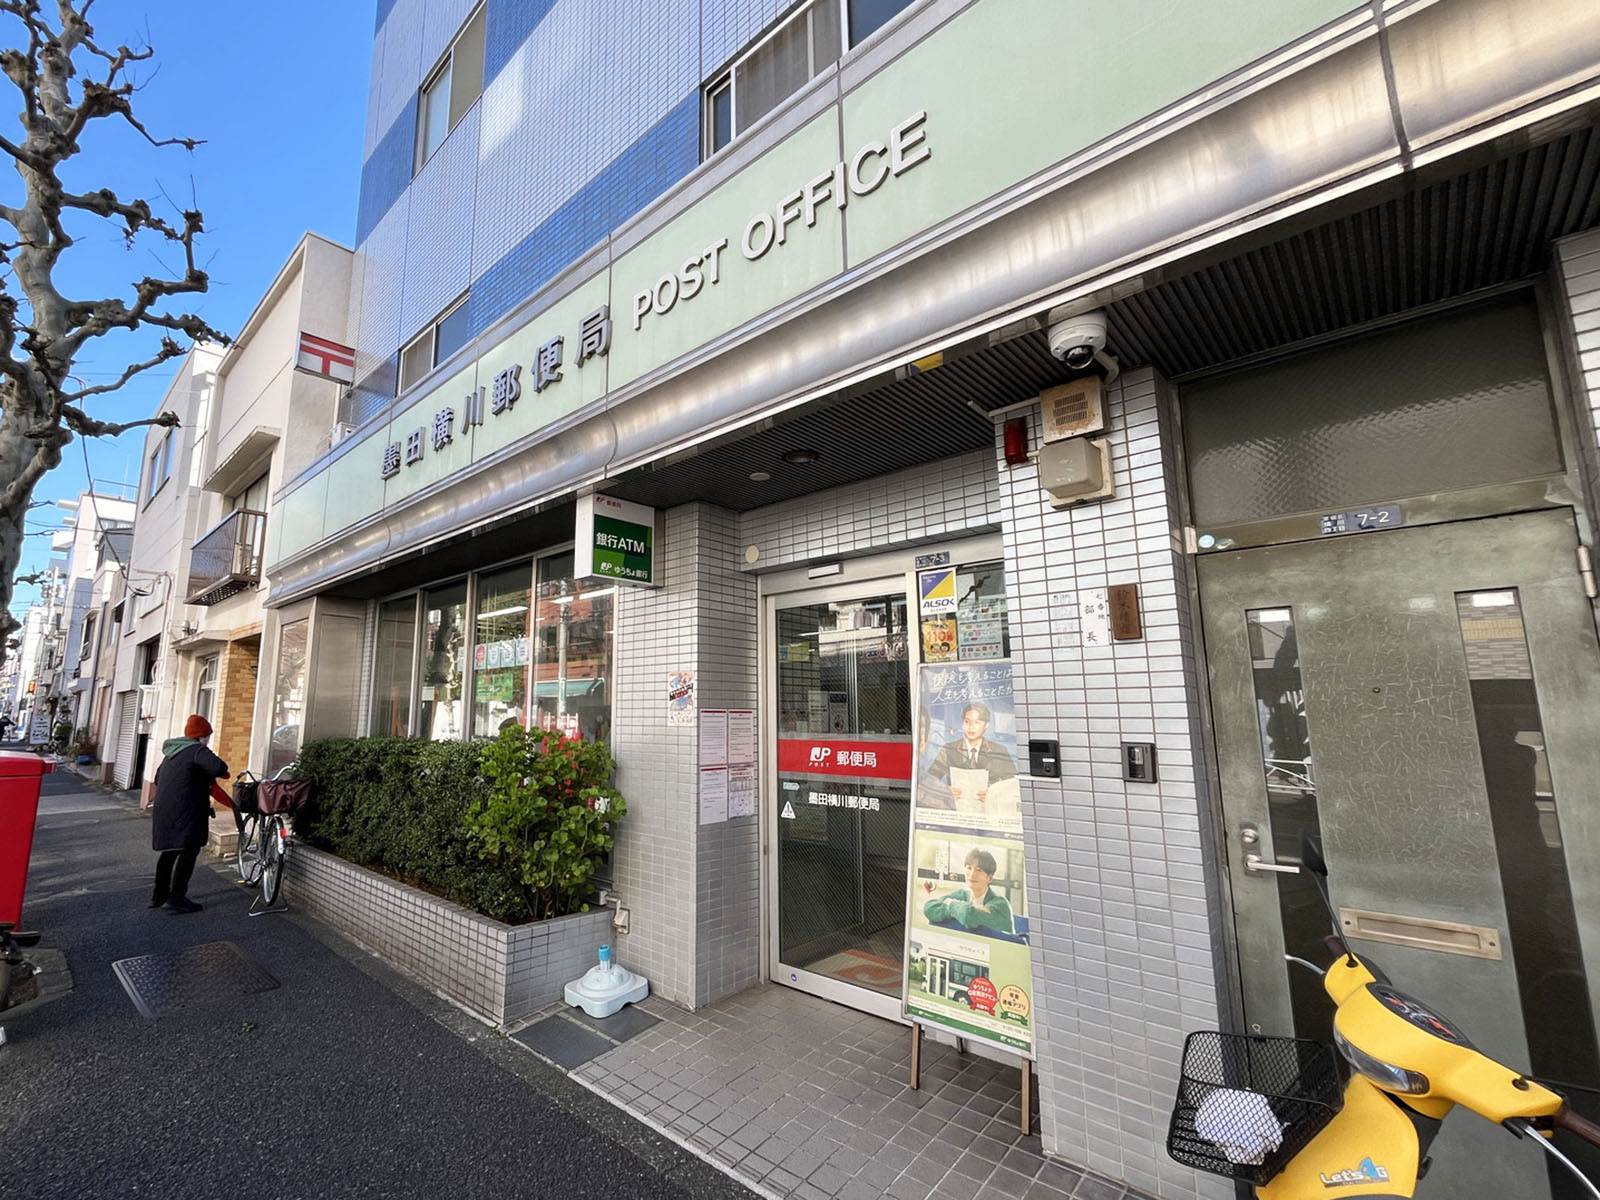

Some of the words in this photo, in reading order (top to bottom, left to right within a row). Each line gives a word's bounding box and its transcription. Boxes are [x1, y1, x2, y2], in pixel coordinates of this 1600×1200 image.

[633, 237, 728, 331] POST
[741, 110, 932, 261] OFFICE
[381, 305, 611, 480] 墨田横川郵便局
[1355, 511, 1390, 525] 7-2
[596, 532, 645, 554] 銀行ATM
[922, 598, 955, 609] ALSOK
[836, 751, 877, 768] 郵便局
[808, 791, 880, 812] 墨田横川郵便局
